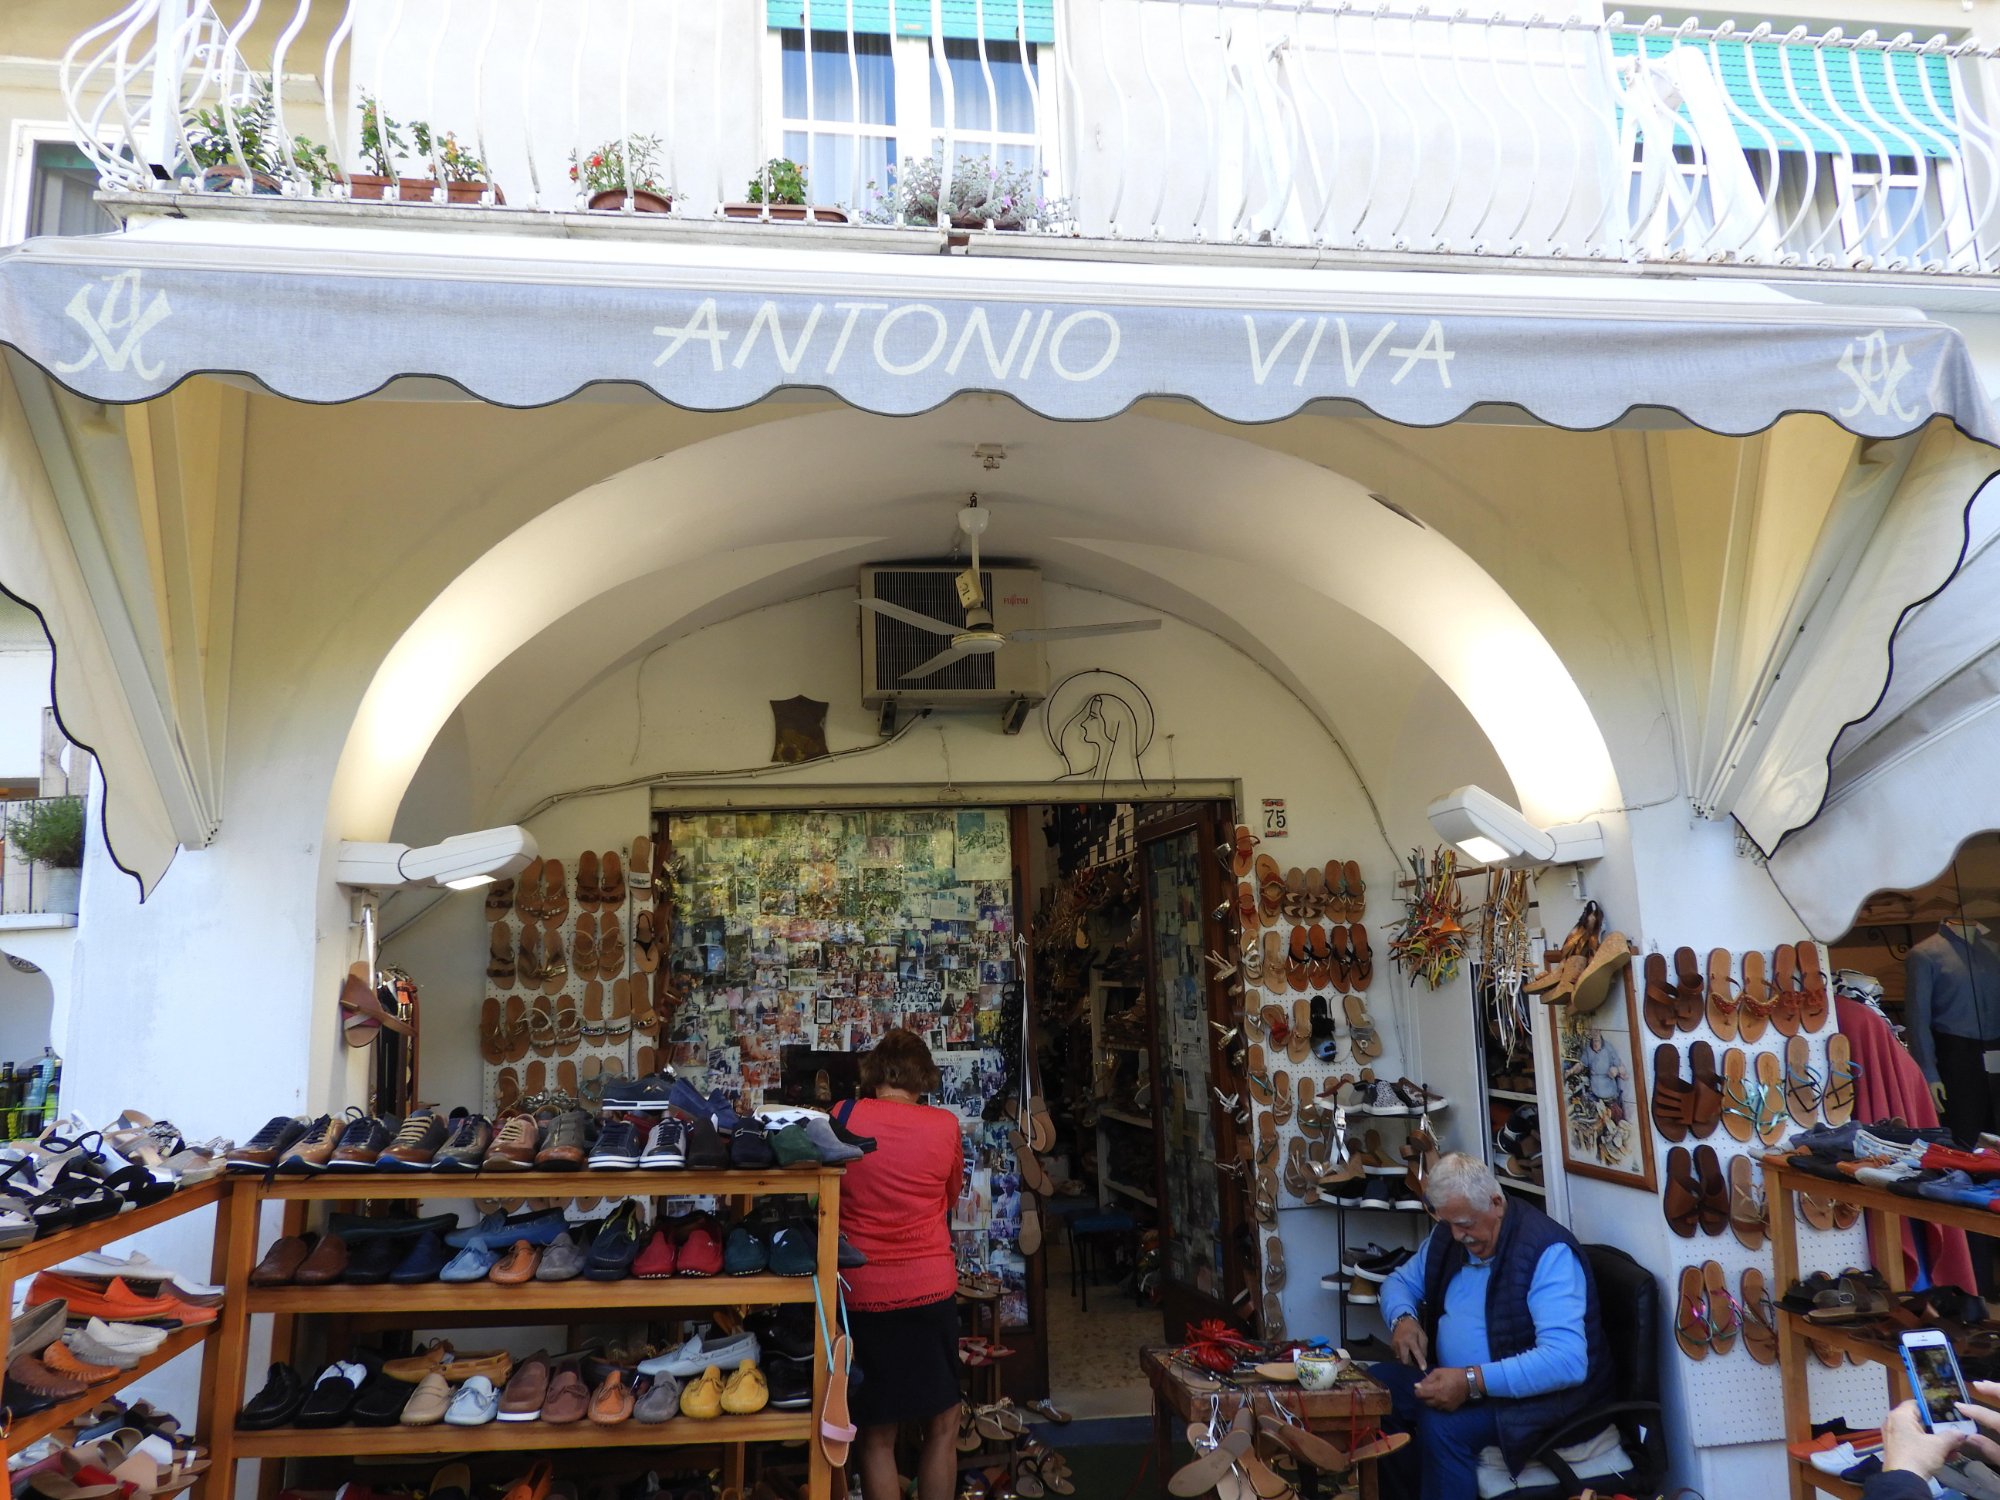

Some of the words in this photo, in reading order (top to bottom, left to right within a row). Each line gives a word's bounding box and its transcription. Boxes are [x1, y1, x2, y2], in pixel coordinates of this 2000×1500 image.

[653, 297, 1121, 381] ANTONIO
[1243, 314, 1456, 388] VIVA
[1264, 809, 1286, 829] 75
